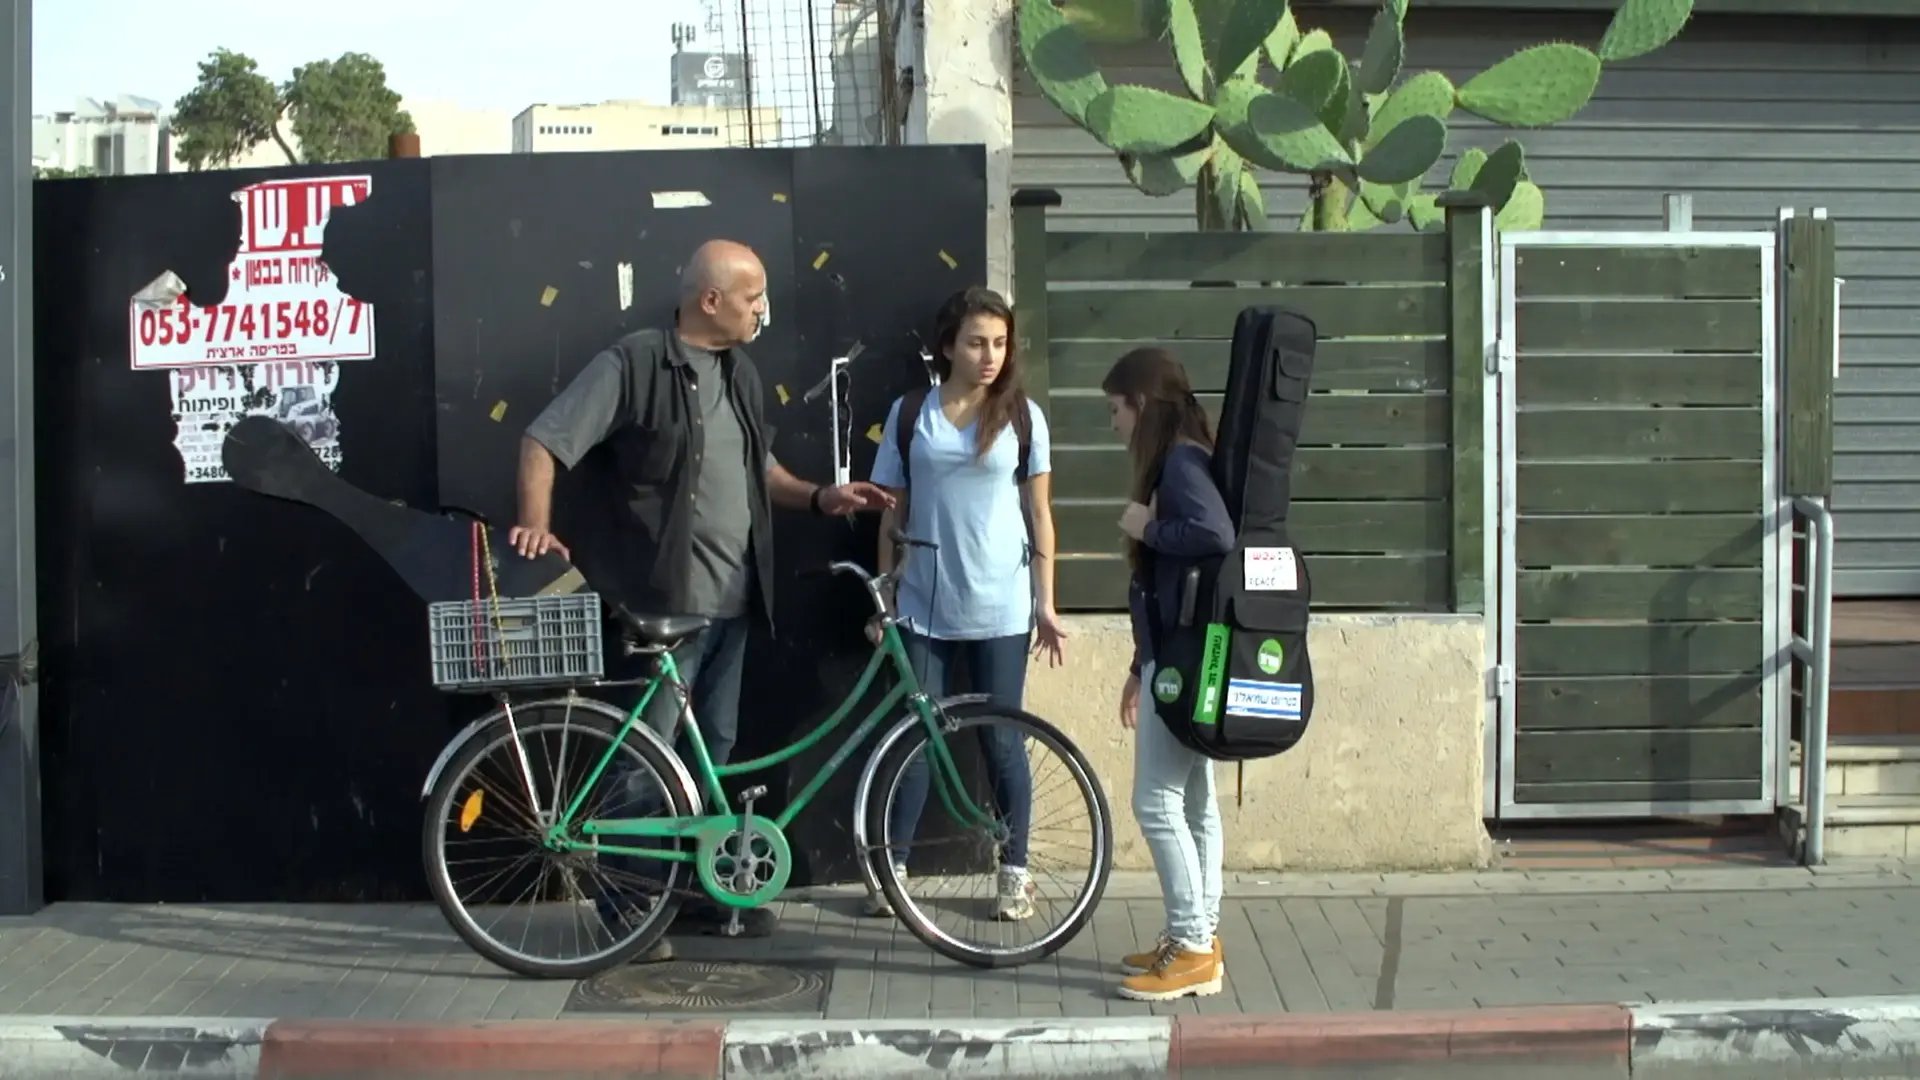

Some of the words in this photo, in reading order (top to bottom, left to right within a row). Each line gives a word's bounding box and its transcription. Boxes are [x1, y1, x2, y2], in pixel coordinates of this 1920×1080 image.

[139, 294, 362, 346] 053-7741548/7
[206, 346, 244, 359] ארצית
[249, 343, 298, 356] בפריסה
[179, 397, 235, 412] ופיתוח
